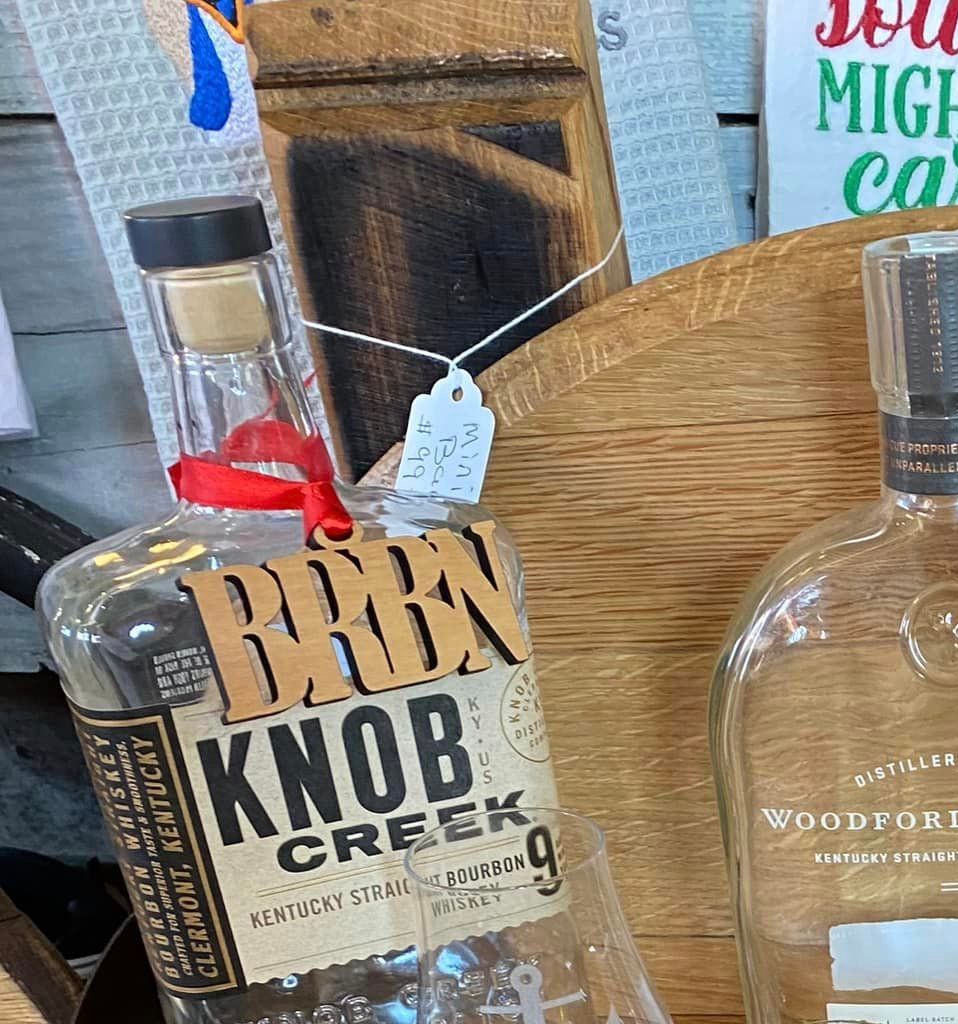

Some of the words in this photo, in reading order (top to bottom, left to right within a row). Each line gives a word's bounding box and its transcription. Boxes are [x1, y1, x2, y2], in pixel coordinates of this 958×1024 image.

[177, 519, 529, 725] BRBN
[93, 734, 141, 850] WHISKEY
[130, 735, 184, 853] KENTUCKY
[197, 693, 474, 846] KNOB
[277, 790, 532, 874] CREEK
[814, 852, 888, 865] KENTUCKY
[133, 864, 181, 980] BOURBON
[170, 863, 218, 979] CLERMONT,
[250, 892, 343, 928] KENTUCKY
[447, 853, 526, 888] BOURBON
